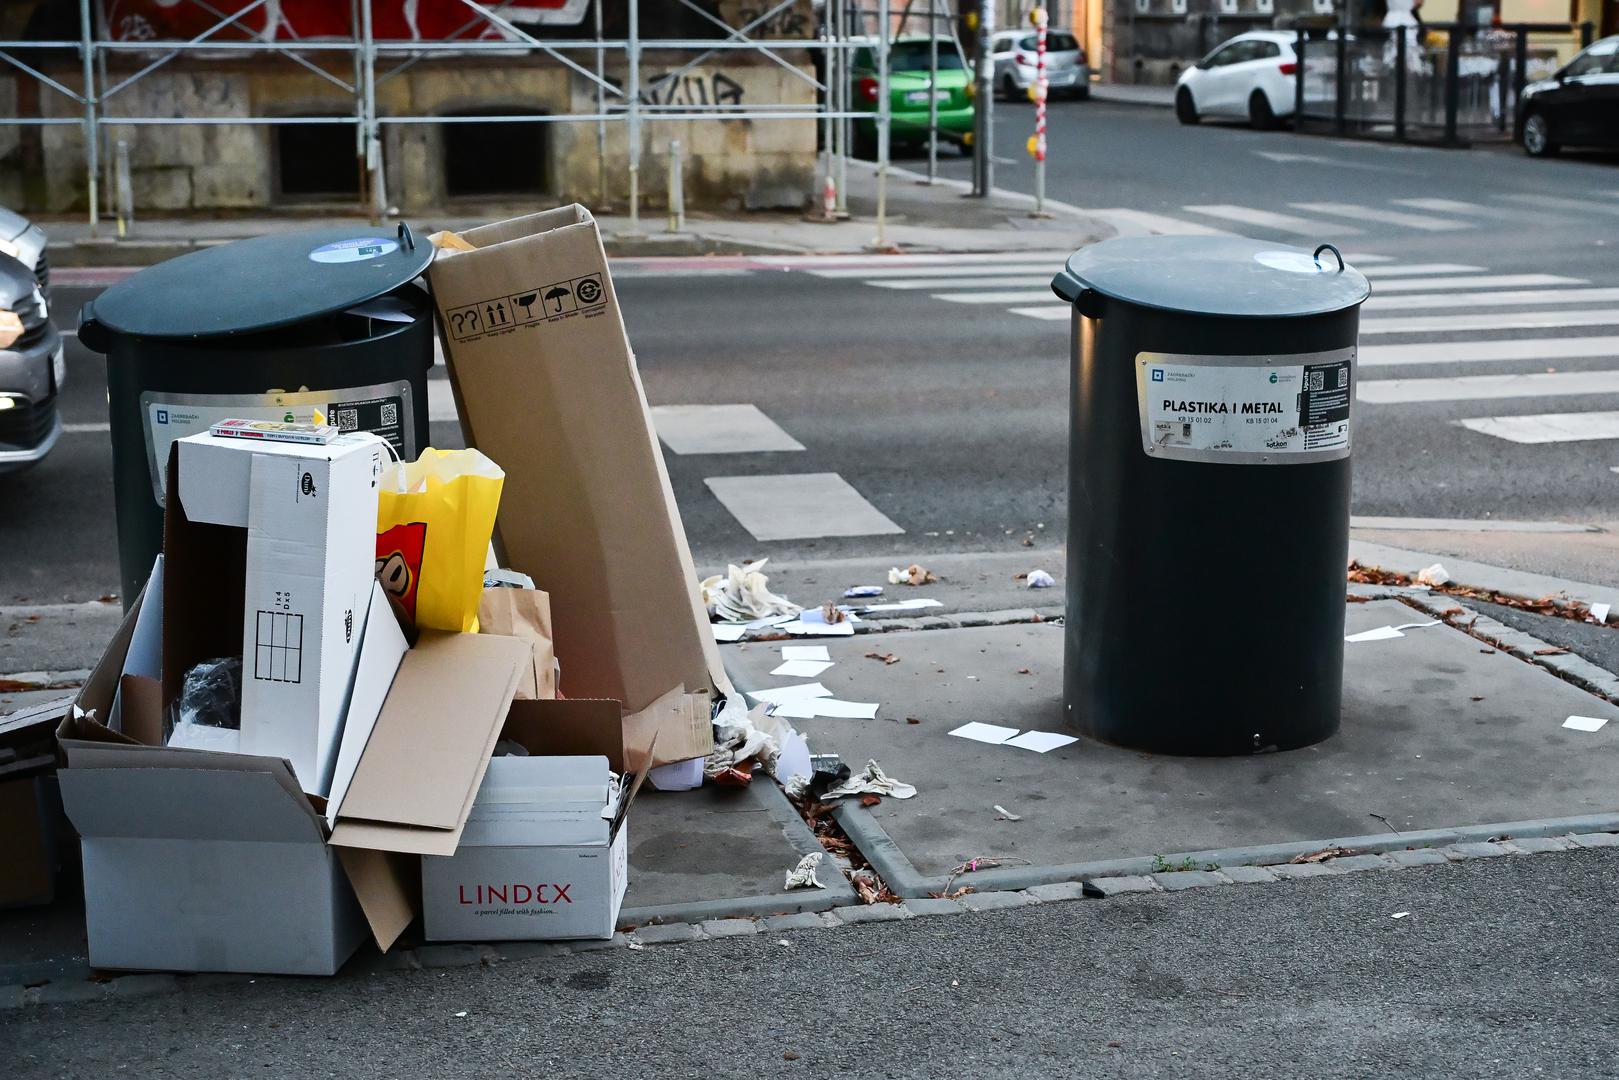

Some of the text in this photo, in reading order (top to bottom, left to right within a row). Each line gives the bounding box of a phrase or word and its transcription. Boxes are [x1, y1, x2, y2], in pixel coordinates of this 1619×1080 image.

[1163, 400, 1283, 414] PLASTIKA I METAL
[329, 410, 337, 426] pute
[459, 884, 573, 904] LINDEX
